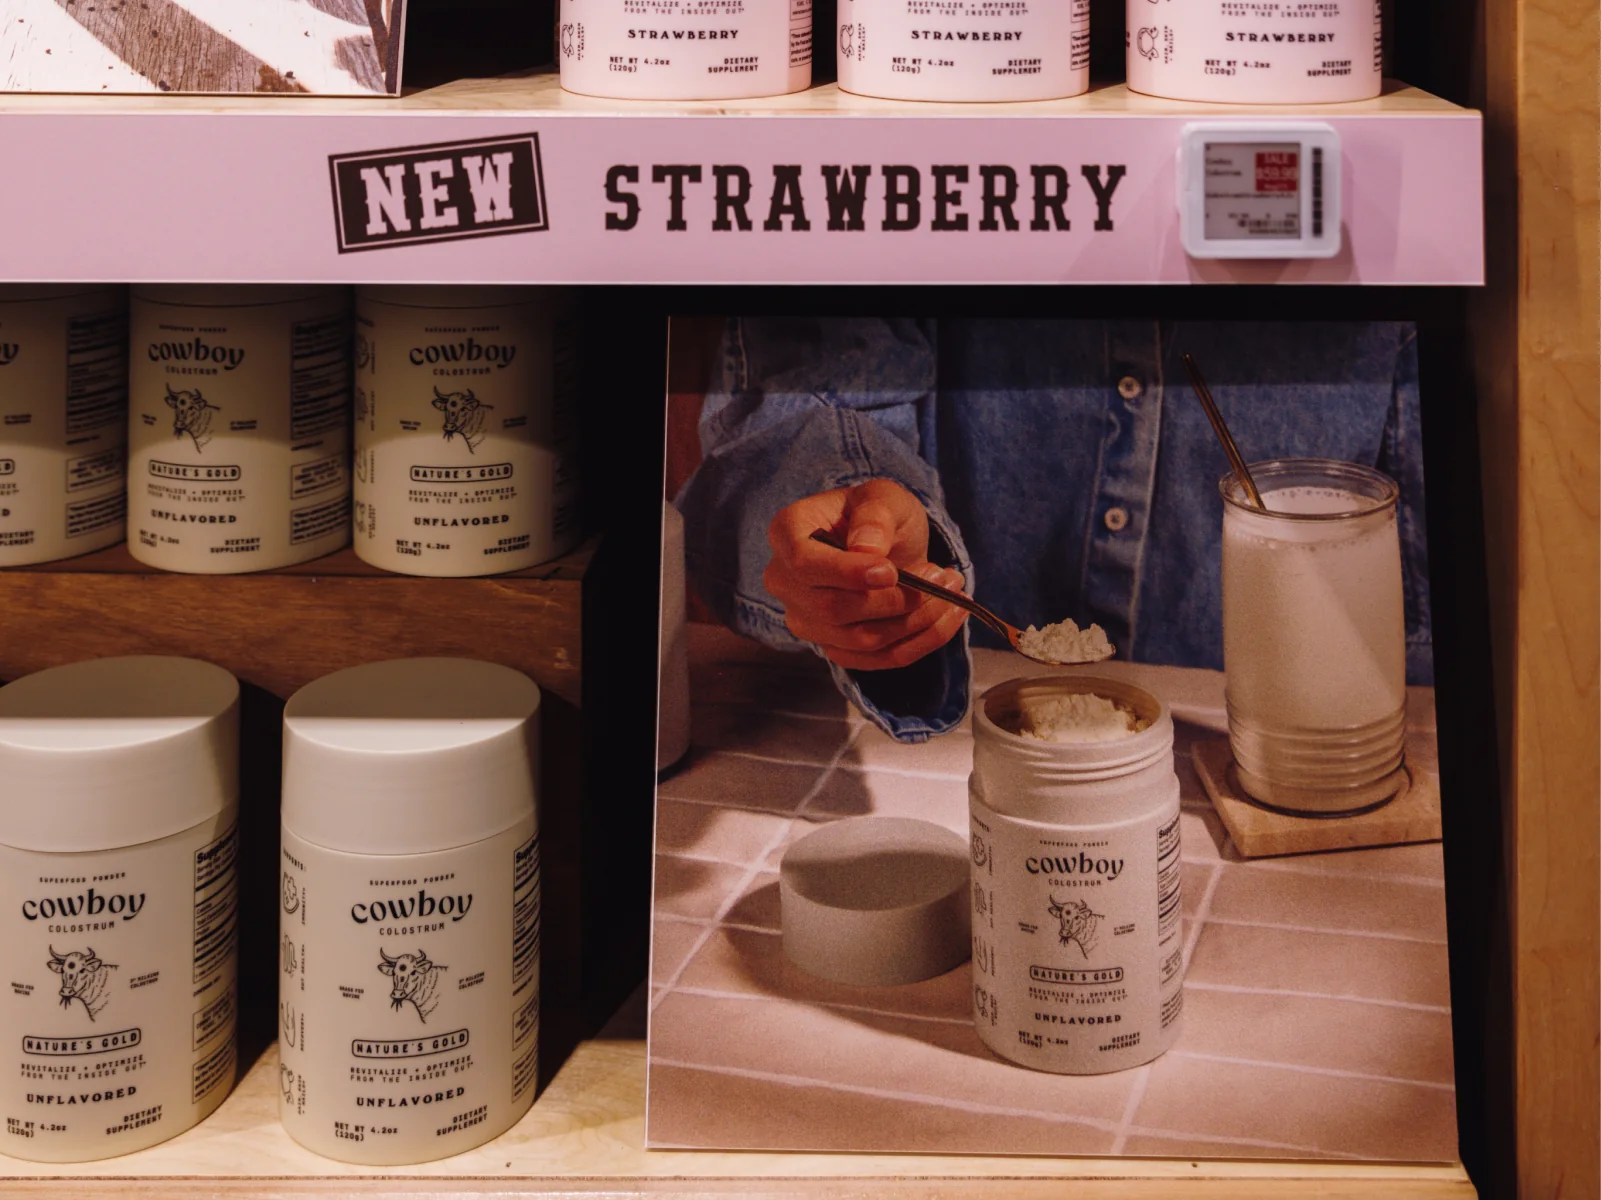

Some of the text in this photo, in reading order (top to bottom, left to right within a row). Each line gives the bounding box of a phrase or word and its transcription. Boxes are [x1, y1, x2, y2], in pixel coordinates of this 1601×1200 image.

[628, 29, 739, 40] STRAWBERRY
[911, 30, 1023, 41] STRAWBERRY
[1226, 32, 1335, 43] STRAWBERRY
[644, 58, 670, 66] 4.2oz
[724, 57, 759, 65] DIETARY
[1008, 58, 1042, 66] DIETARY
[708, 65, 759, 73] SUPPLEMENT
[992, 67, 1042, 75] SUPPLEMENT
[359, 150, 516, 236] NEW
[603, 163, 1127, 232] STRAWBERRY
[148, 337, 245, 371] cowboy
[409, 338, 517, 368] cowboy
[433, 368, 491, 376] COLOSTRUM
[207, 468, 237, 478] GOLD
[480, 466, 509, 478] GOLD
[151, 509, 237, 523] UNFLAVORED
[414, 514, 509, 527] UNFLAVORED
[1025, 852, 1124, 880] cowboy
[22, 888, 146, 921] cowboy
[351, 889, 473, 924] cowboy
[48, 921, 115, 933] COLOSTRUM
[379, 922, 445, 936] COLOSTRUM
[1093, 967, 1121, 981] GOLD
[1034, 1012, 1122, 1025] UNFLAVORED
[102, 1033, 138, 1048] GOLD
[432, 1033, 466, 1049] GOLD
[26, 1086, 137, 1105] UNFLAVORED
[356, 1086, 466, 1108] UNFLAVORED
[124, 1105, 163, 1123] DIETARY
[452, 1105, 488, 1124] DIETARY
[106, 1113, 163, 1135] SUPPLEMENT
[371, 1127, 398, 1135] 4.2oz
[436, 1113, 488, 1136] SUPPLEMENT
